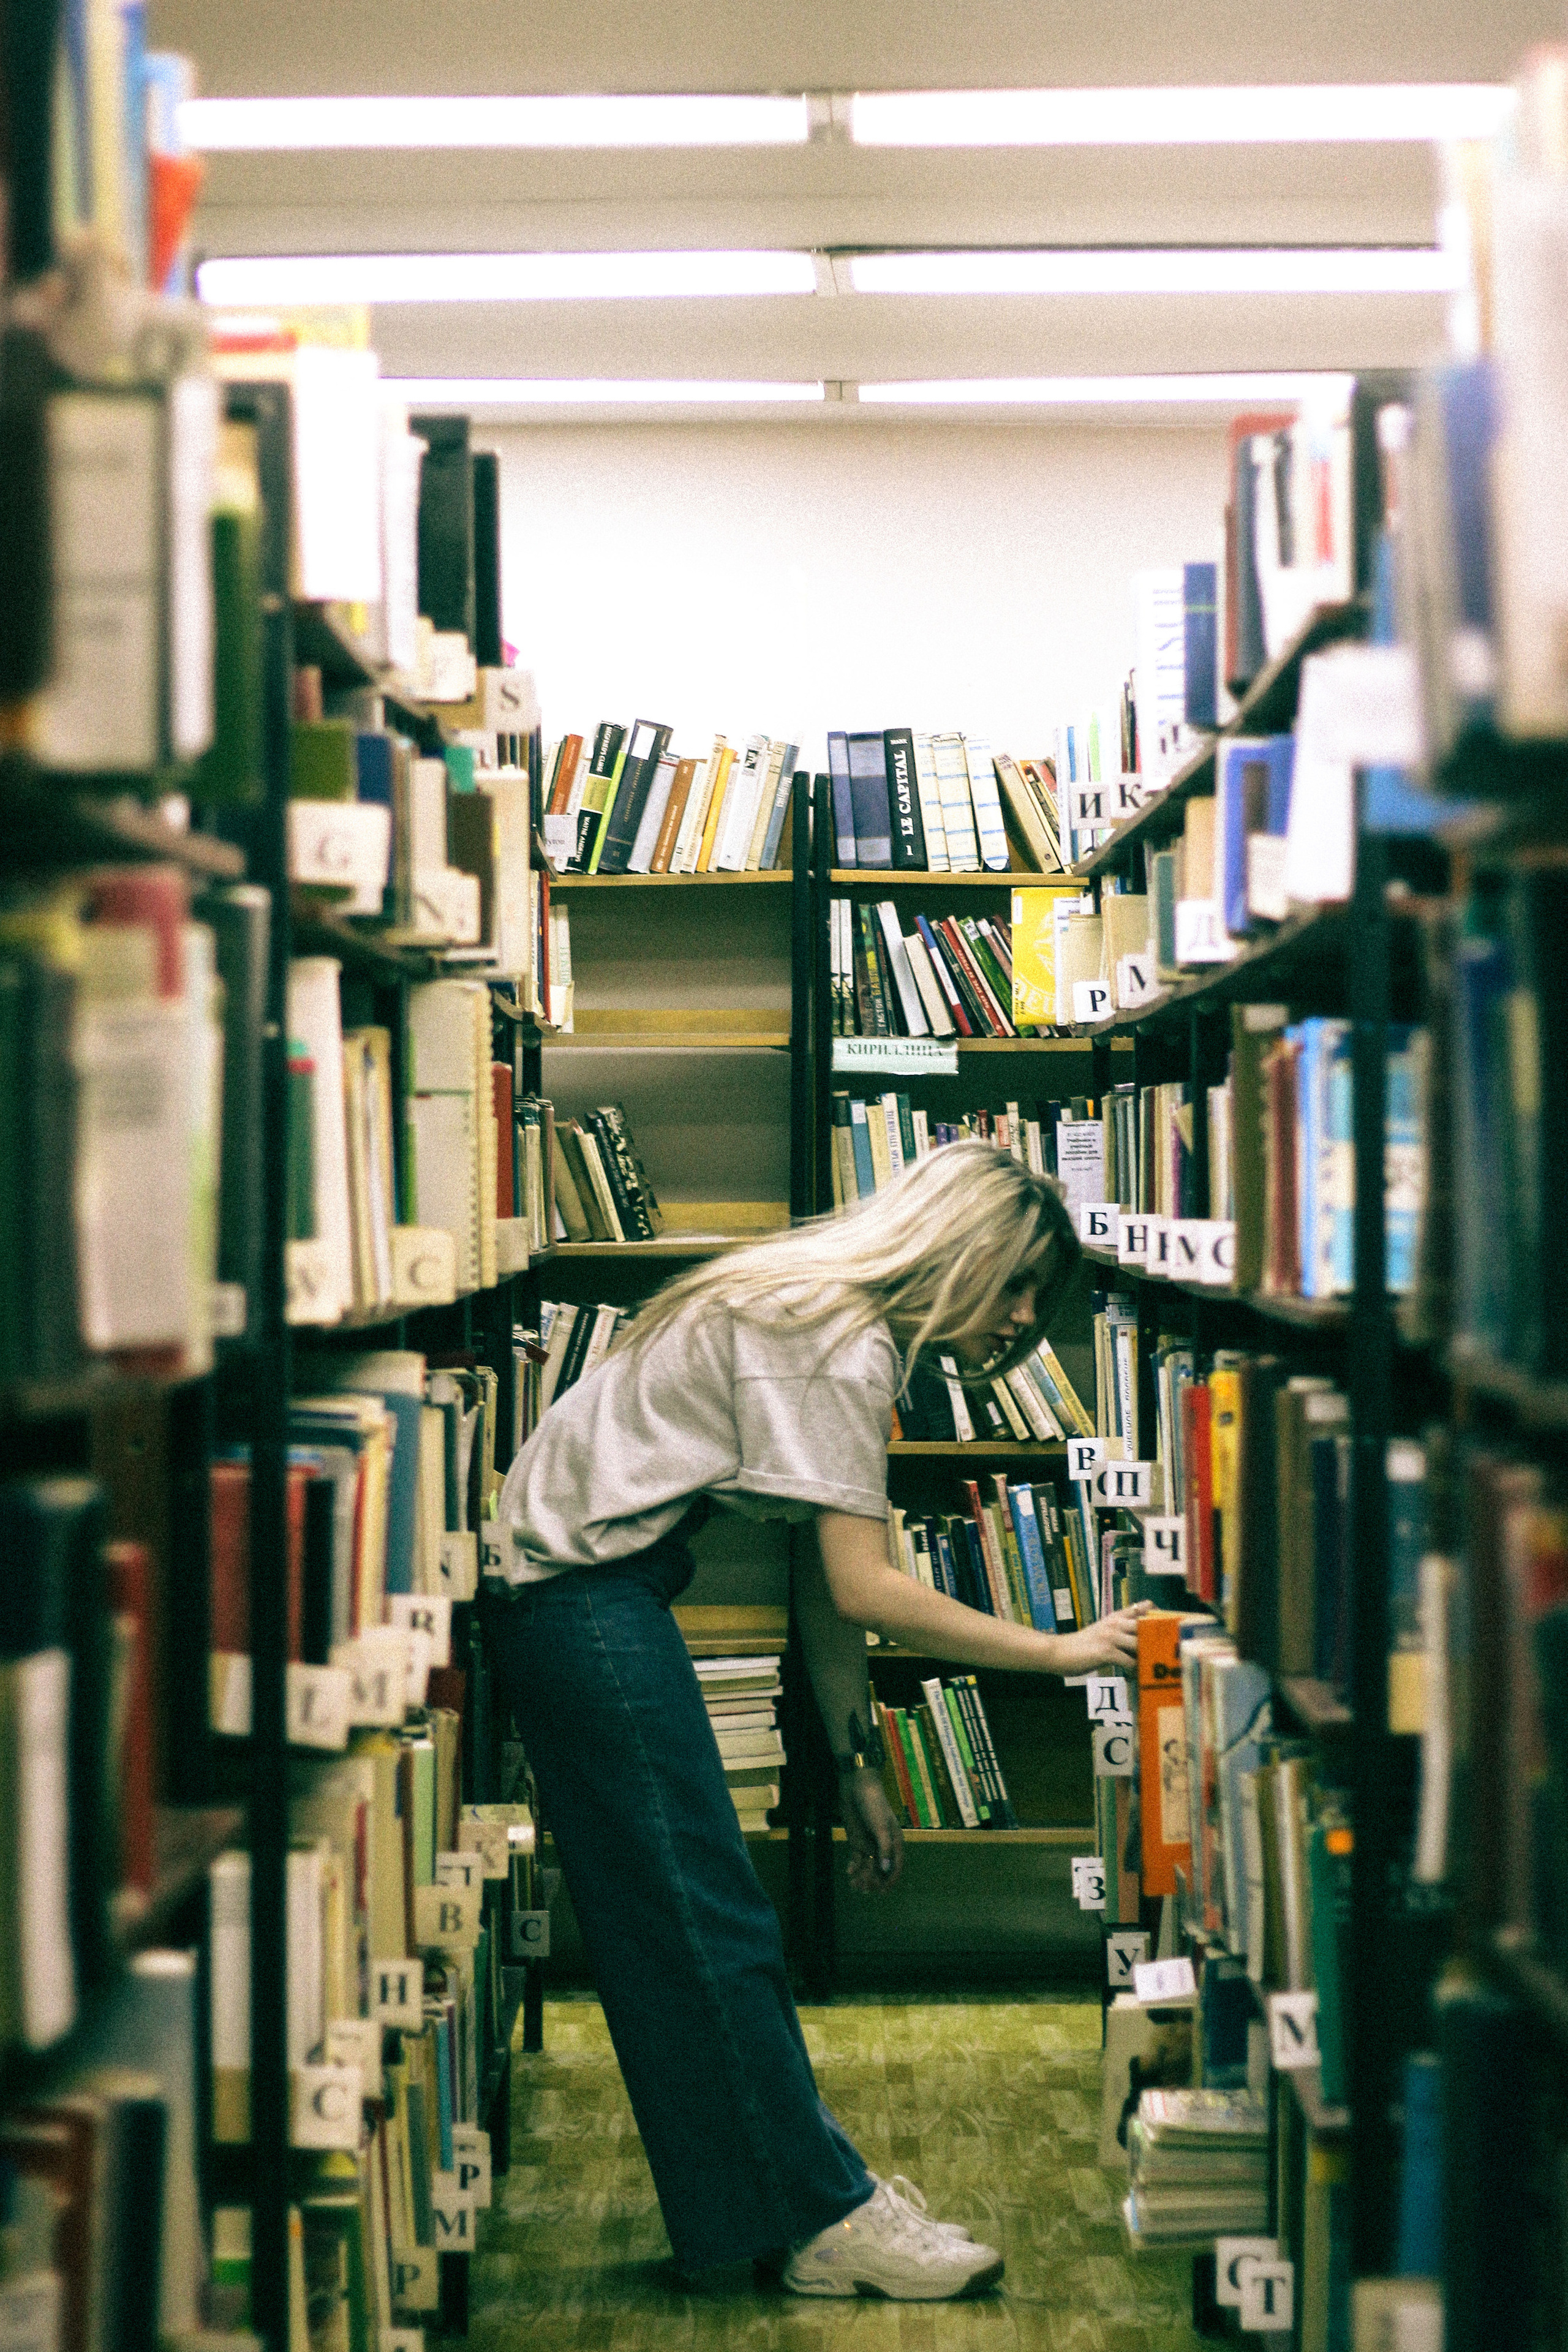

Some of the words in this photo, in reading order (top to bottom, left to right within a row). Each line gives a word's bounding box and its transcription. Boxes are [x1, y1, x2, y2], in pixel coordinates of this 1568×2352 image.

[499, 684, 521, 712] S
[894, 749, 912, 813] CAPITAL
[1079, 793, 1102, 819] И
[901, 815, 914, 837] LE
[1087, 1211, 1110, 1236] Б
[1076, 1446, 1096, 1471] В
[1115, 1470, 1142, 1497] П
[1154, 1529, 1180, 1561] Ч
[1095, 1686, 1119, 1713] Д
[1104, 1737, 1129, 1765] С
[1088, 1876, 1106, 1899] З
[519, 1918, 541, 1943] C
[1115, 1948, 1139, 1976] У
[458, 2163, 481, 2192] P
[435, 2209, 467, 2237] M
[1252, 2275, 1286, 2315] Т
